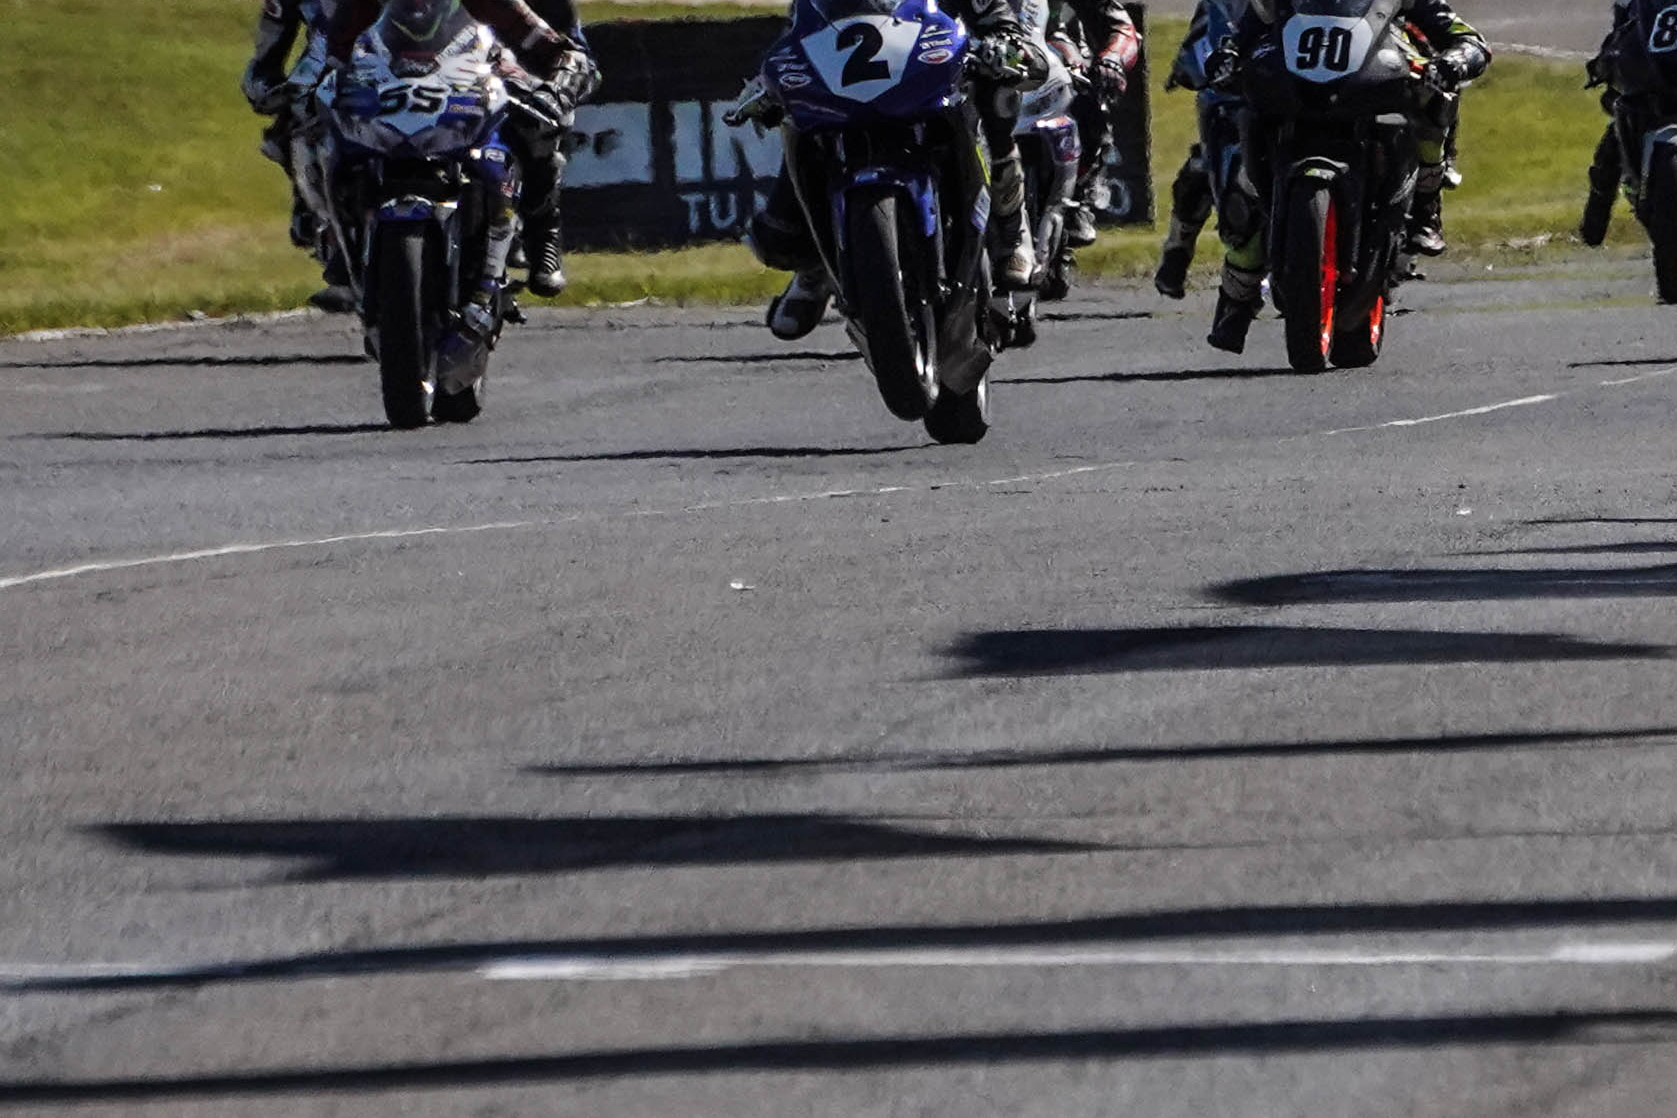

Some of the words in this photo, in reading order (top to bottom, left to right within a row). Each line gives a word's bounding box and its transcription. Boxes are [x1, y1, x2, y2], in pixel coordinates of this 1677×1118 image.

[836, 23, 891, 87] 2
[1296, 26, 1352, 71] 90
[378, 84, 446, 115] 55
